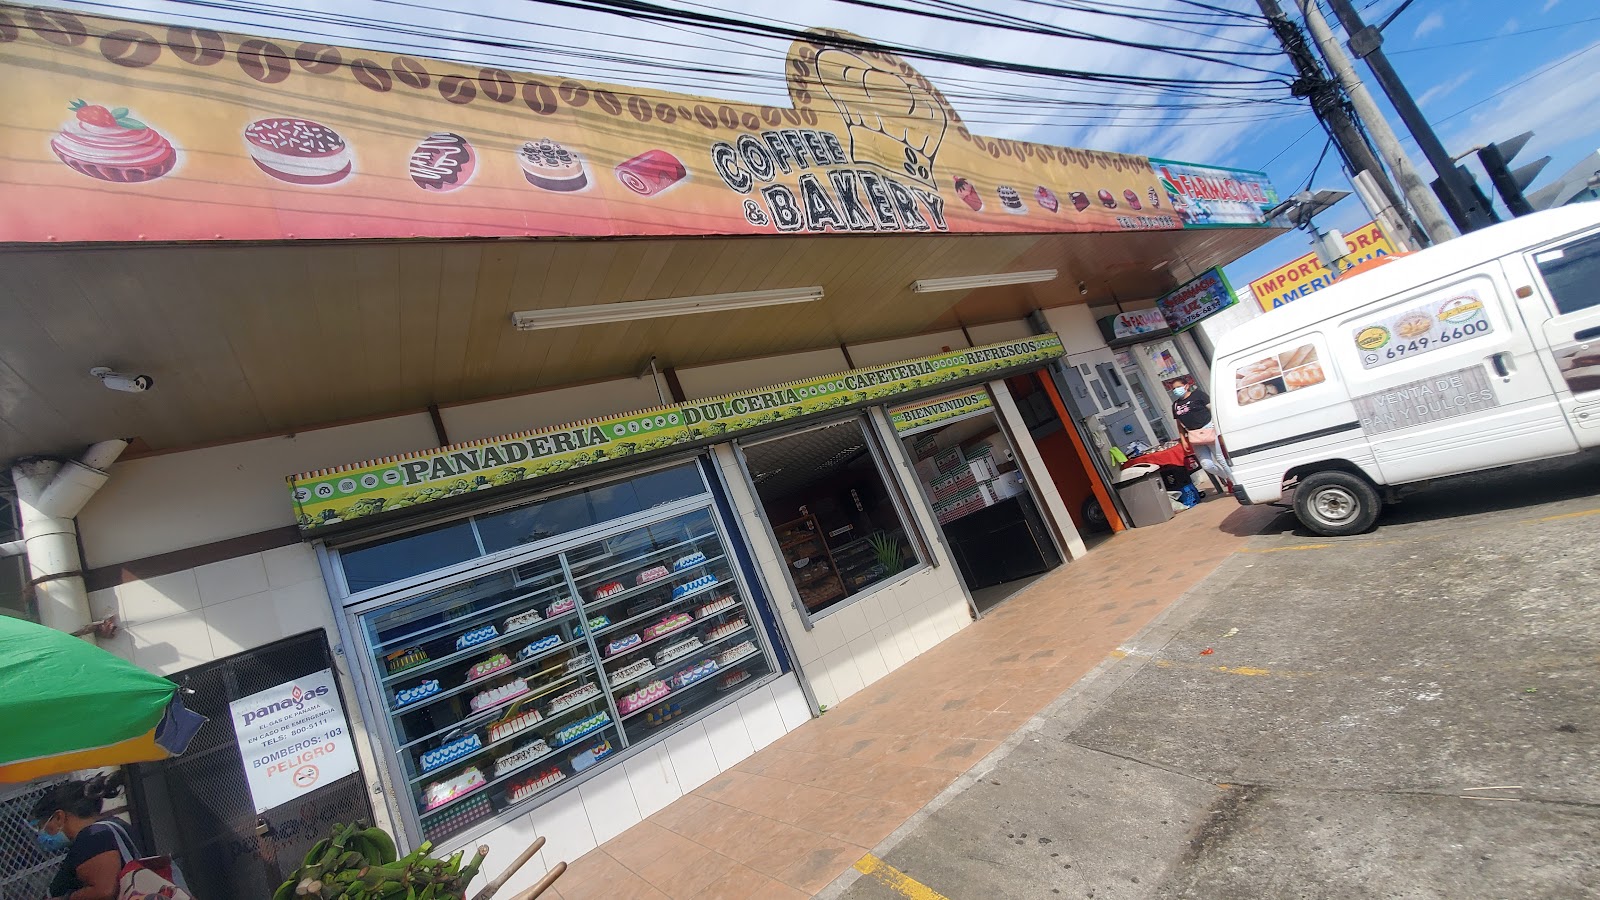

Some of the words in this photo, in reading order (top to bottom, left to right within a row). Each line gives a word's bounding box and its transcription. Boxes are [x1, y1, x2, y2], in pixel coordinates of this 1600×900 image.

[711, 129, 848, 194] COFFEE
[743, 199, 770, 226] &
[761, 169, 948, 232] BAKERY
[1178, 174, 1249, 203] FARMACIA
[1256, 228, 1384, 297] IMPORTORA
[1172, 277, 1216, 306] FARMACIA
[1130, 311, 1166, 328] FARMAC
[1386, 319, 1489, 359] 6949-6600
[903, 393, 979, 423] BIENVENIDOS
[1374, 385, 1433, 407] VENTA
[1437, 374, 1464, 392] DE
[401, 425, 609, 486] PANADERIA
[682, 386, 801, 424] DULCERIA
[844, 359, 935, 392] CAFETERIA
[965, 340, 1037, 366] REFRESCOS
[1362, 411, 1396, 429] PAN
[1400, 408, 1411, 419] Y
[1415, 389, 1493, 416] DULCES
[242, 685, 329, 727] panagas
[259, 723, 269, 731] EL
[270, 719, 283, 727] GAS
[294, 704, 321, 717] PANAMA
[259, 729, 279, 741] CASO
[292, 708, 335, 728] EMERGENCIA
[261, 734, 287, 748] TELS:
[291, 718, 328, 737] 800-5111
[252, 736, 321, 769] BOMBEROS:
[324, 727, 342, 740] 103
[267, 742, 336, 778] PELIGRO
